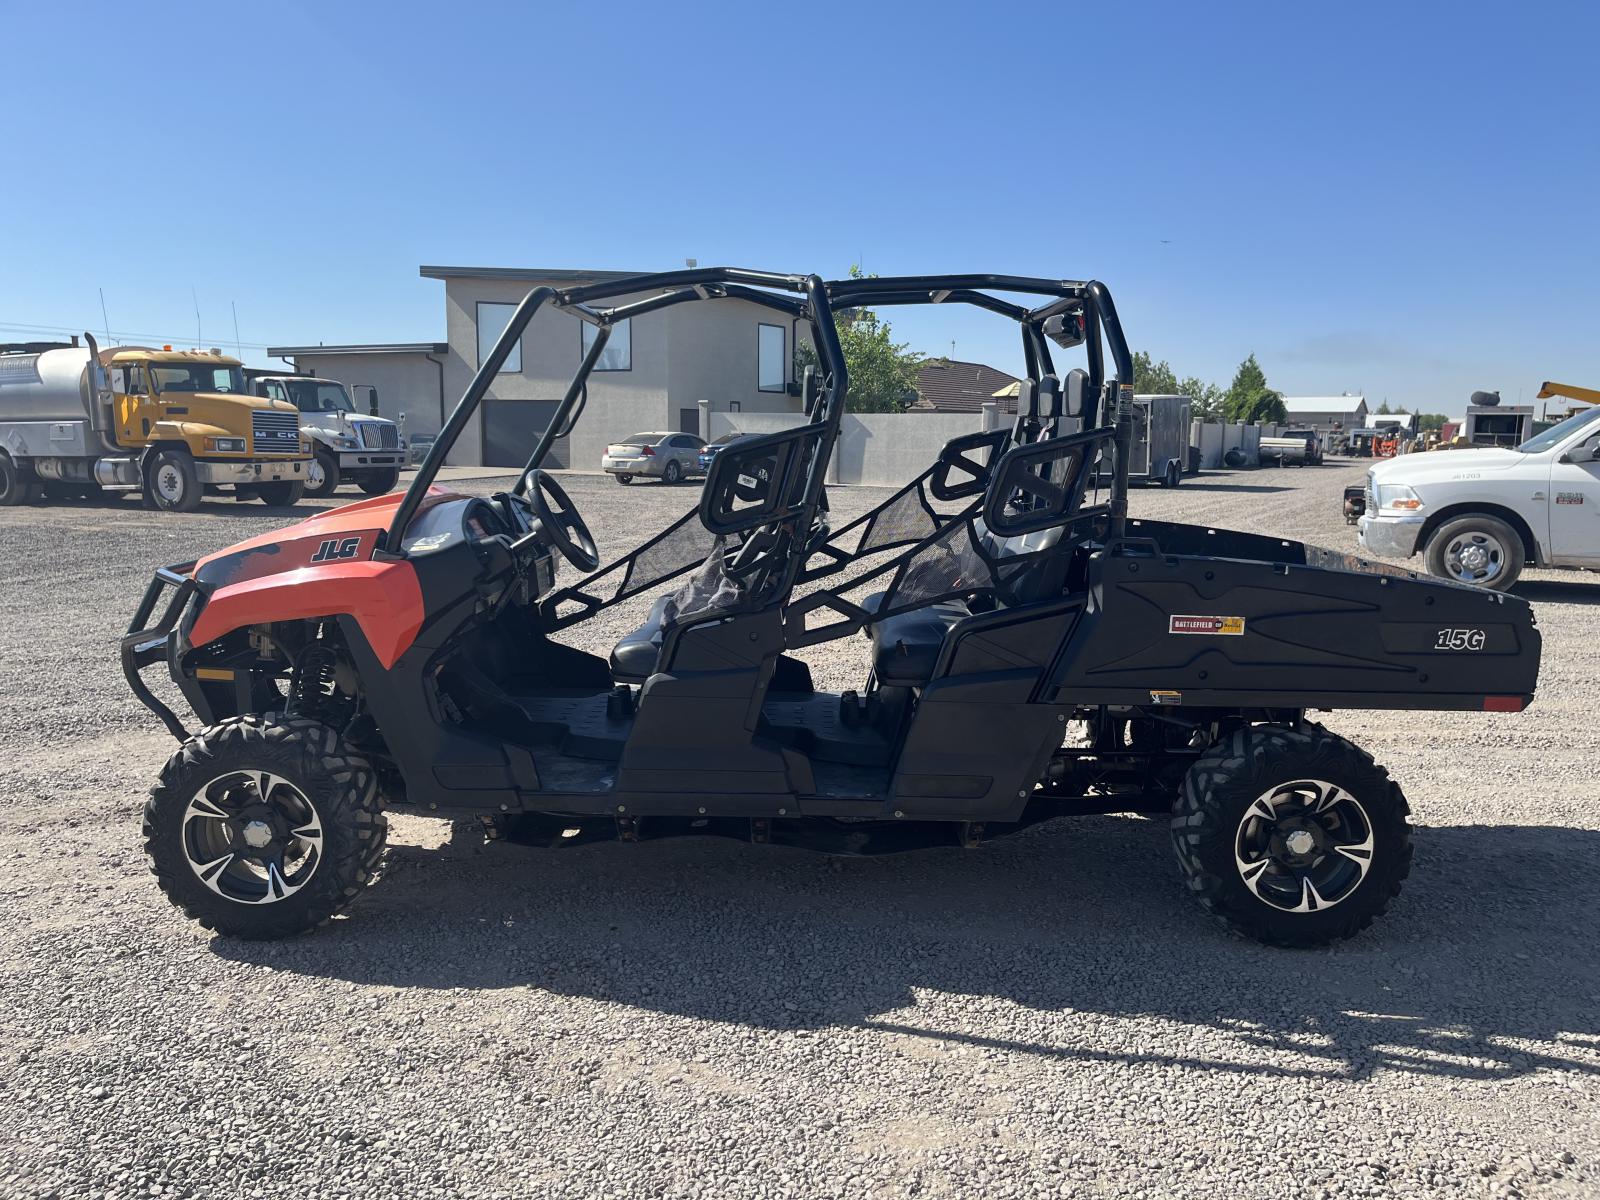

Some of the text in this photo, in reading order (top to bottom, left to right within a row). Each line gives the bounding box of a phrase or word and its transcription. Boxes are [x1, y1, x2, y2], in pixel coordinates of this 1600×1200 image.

[255, 431, 297, 439] MCK
[310, 536, 361, 563] JLG
[1174, 620, 1213, 629] BATTLEFIELD
[1434, 628, 1486, 650] 15G
